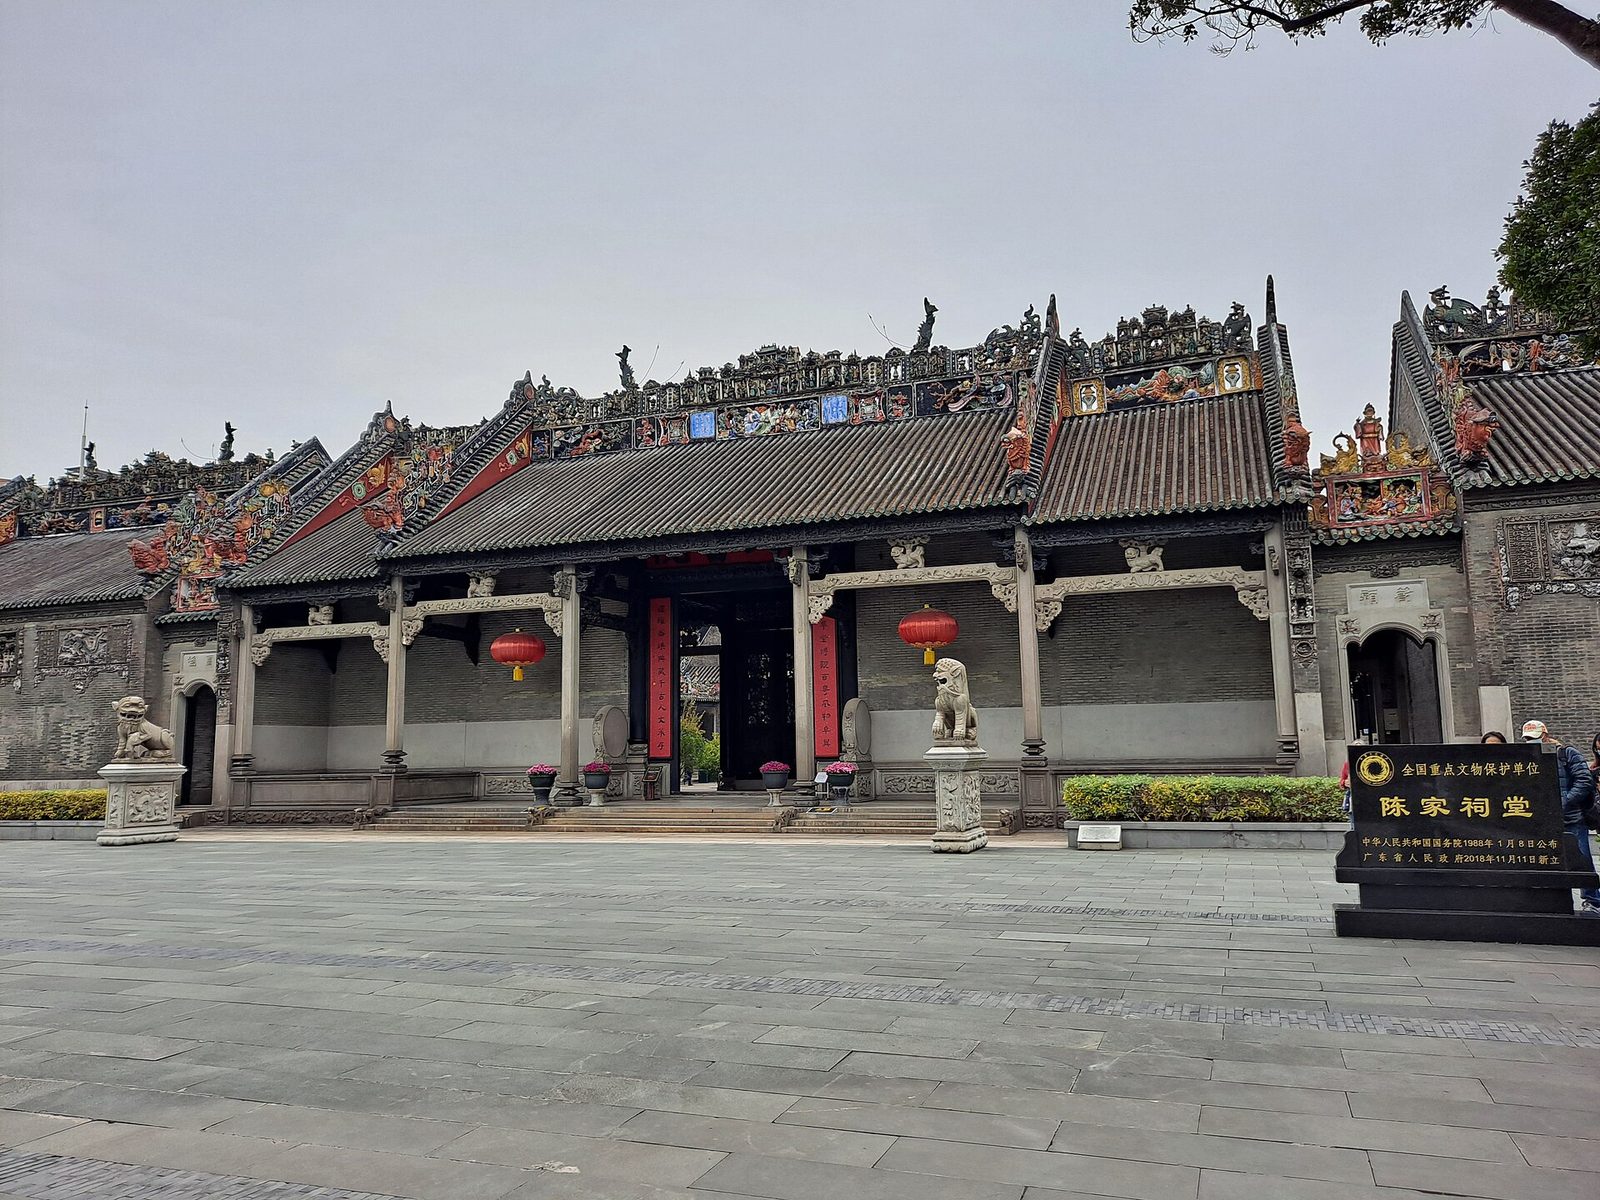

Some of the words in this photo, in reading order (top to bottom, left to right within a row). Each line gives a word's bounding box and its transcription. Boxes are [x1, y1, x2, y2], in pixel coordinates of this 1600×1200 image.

[1401, 762, 1540, 776] 全国重点文物保护单位
[1379, 795, 1534, 818] 陈家祠堂
[1363, 852, 1560, 865] 广东省人民政府2018年11月11日新立
